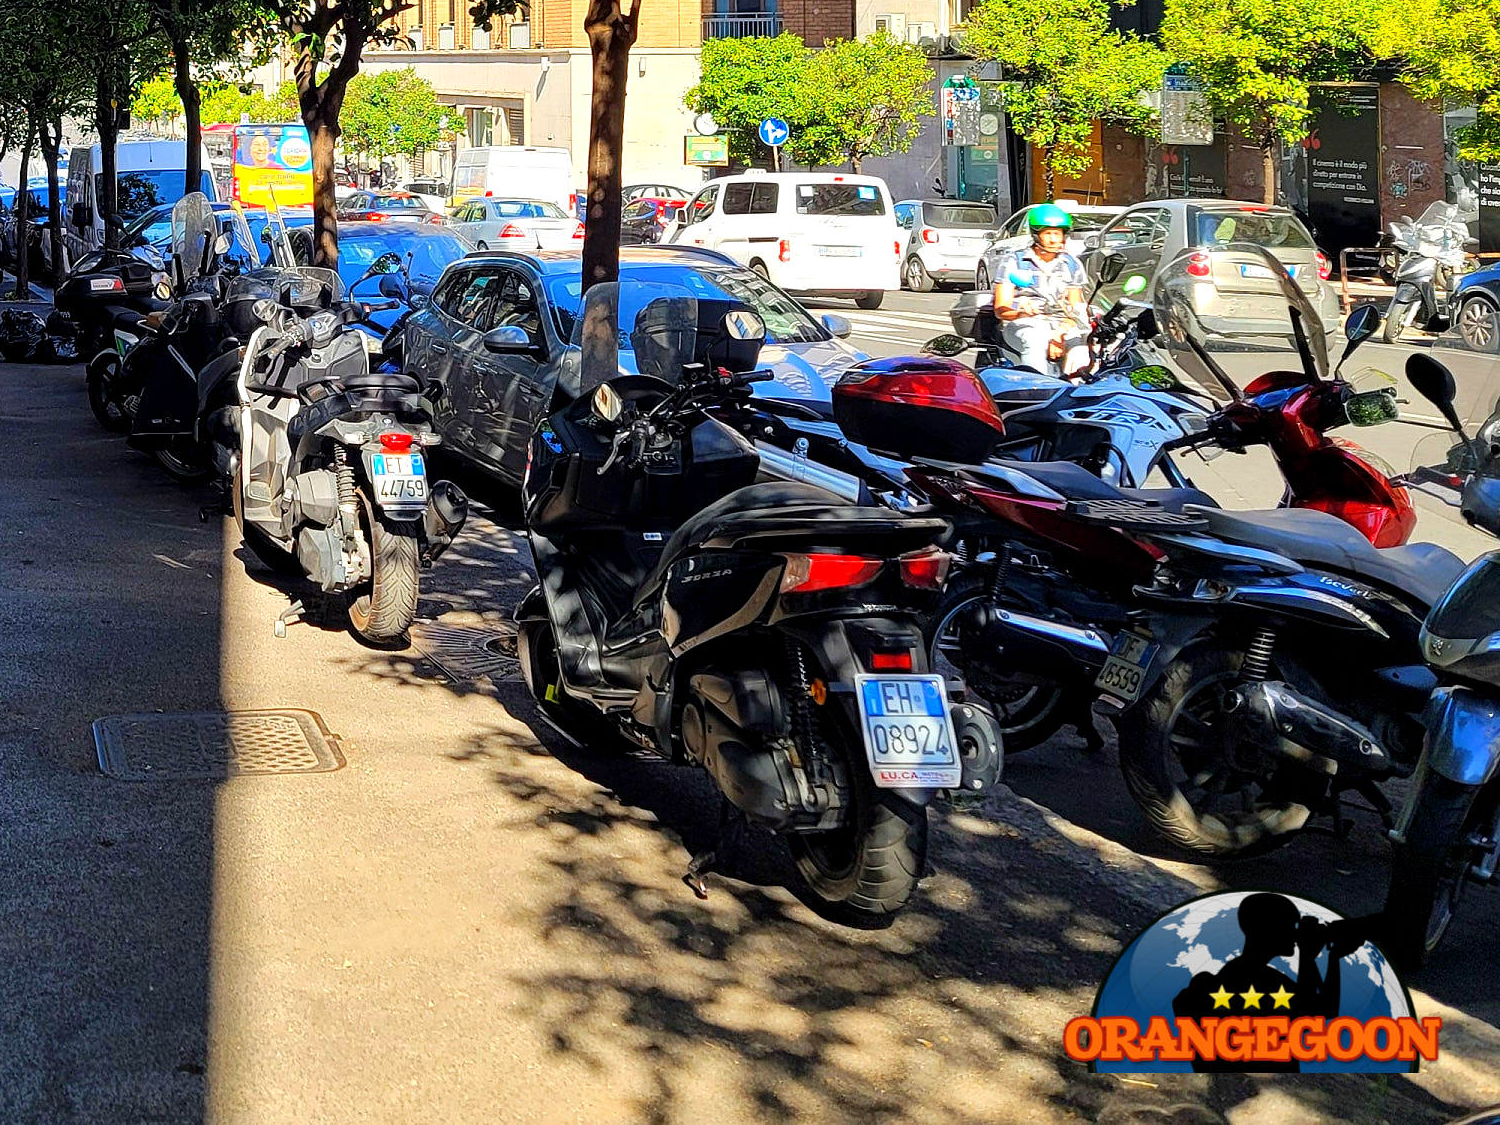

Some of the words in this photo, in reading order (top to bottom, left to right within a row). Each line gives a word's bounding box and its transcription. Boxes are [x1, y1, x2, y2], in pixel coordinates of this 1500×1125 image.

[385, 457, 402, 473] ET
[381, 479, 424, 497] 44759
[881, 683, 913, 713] EH
[873, 724, 949, 755] 08924
